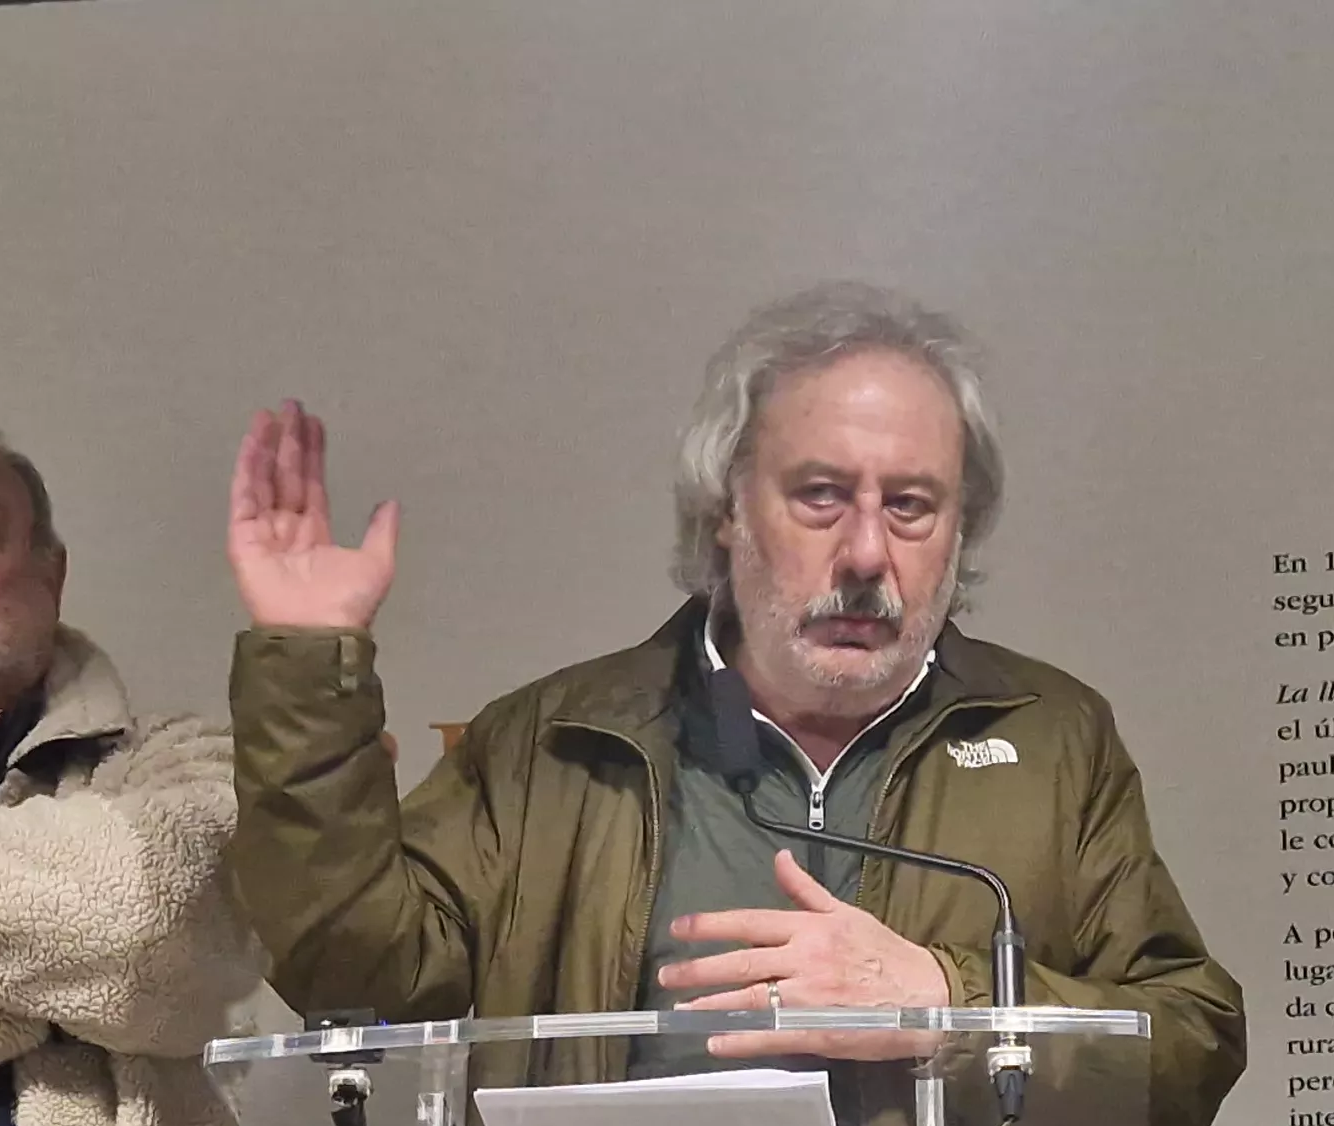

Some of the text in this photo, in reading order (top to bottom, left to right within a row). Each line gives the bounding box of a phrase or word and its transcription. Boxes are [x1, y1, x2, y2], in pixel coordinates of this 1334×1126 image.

[1274, 555, 1306, 573] En
[1275, 632, 1307, 646] en
[1277, 685, 1308, 704] La
[1278, 719, 1300, 740] el
[1281, 830, 1303, 850] le
[1282, 873, 1297, 893] y
[1284, 924, 1302, 943] A
[1286, 996, 1316, 1017] da
